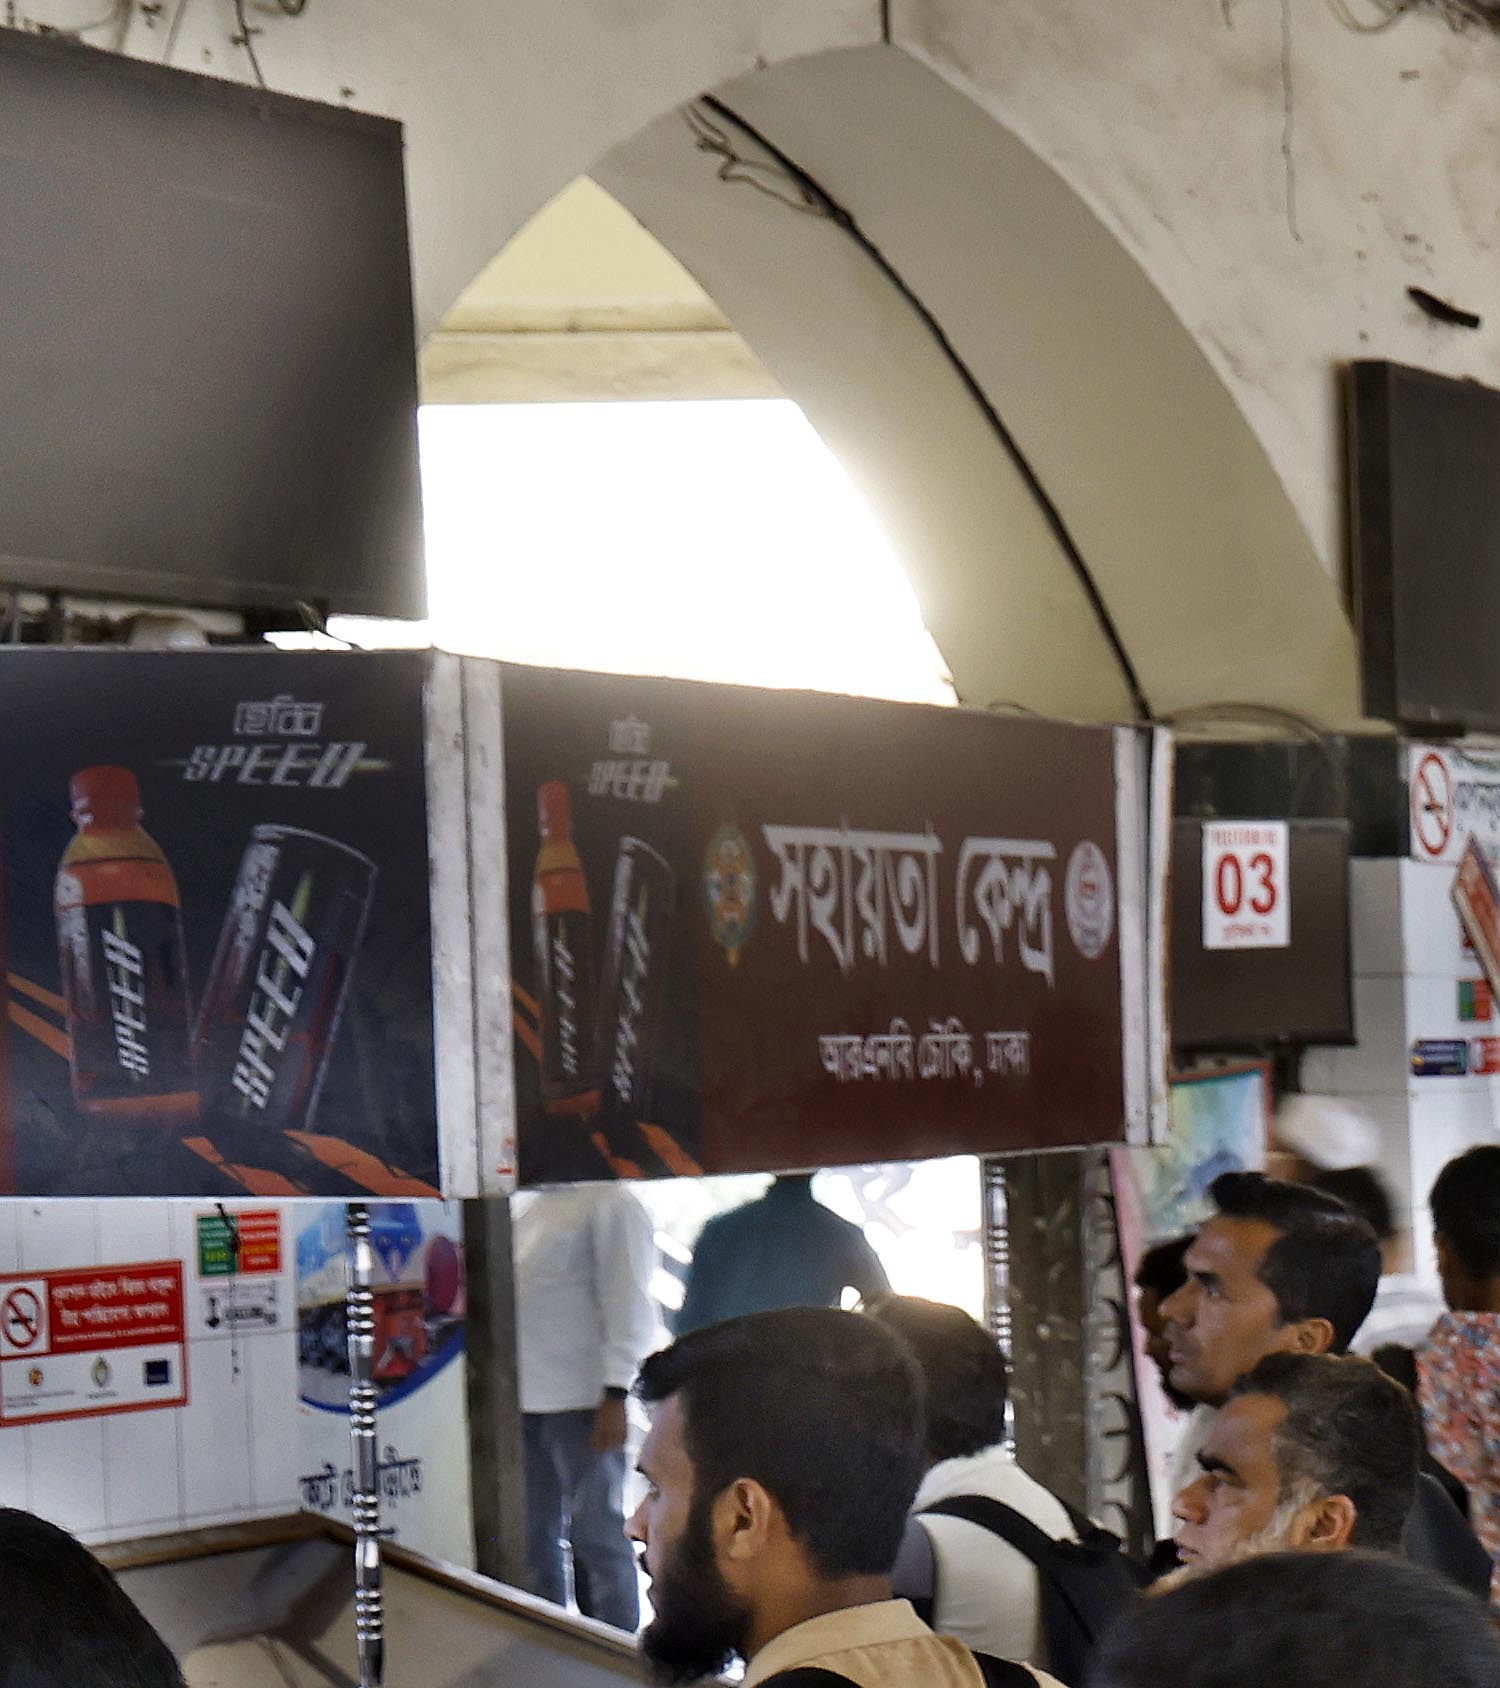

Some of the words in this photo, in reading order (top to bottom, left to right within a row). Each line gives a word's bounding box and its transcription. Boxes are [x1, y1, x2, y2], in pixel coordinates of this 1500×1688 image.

[184, 743, 367, 788] SPEED
[760, 815, 945, 975] সহায়তা
[956, 836, 1057, 990] কেন্দ্র
[1216, 853, 1277, 915] 03
[101, 927, 150, 1078] SPEED
[231, 899, 317, 1111] SPEED
